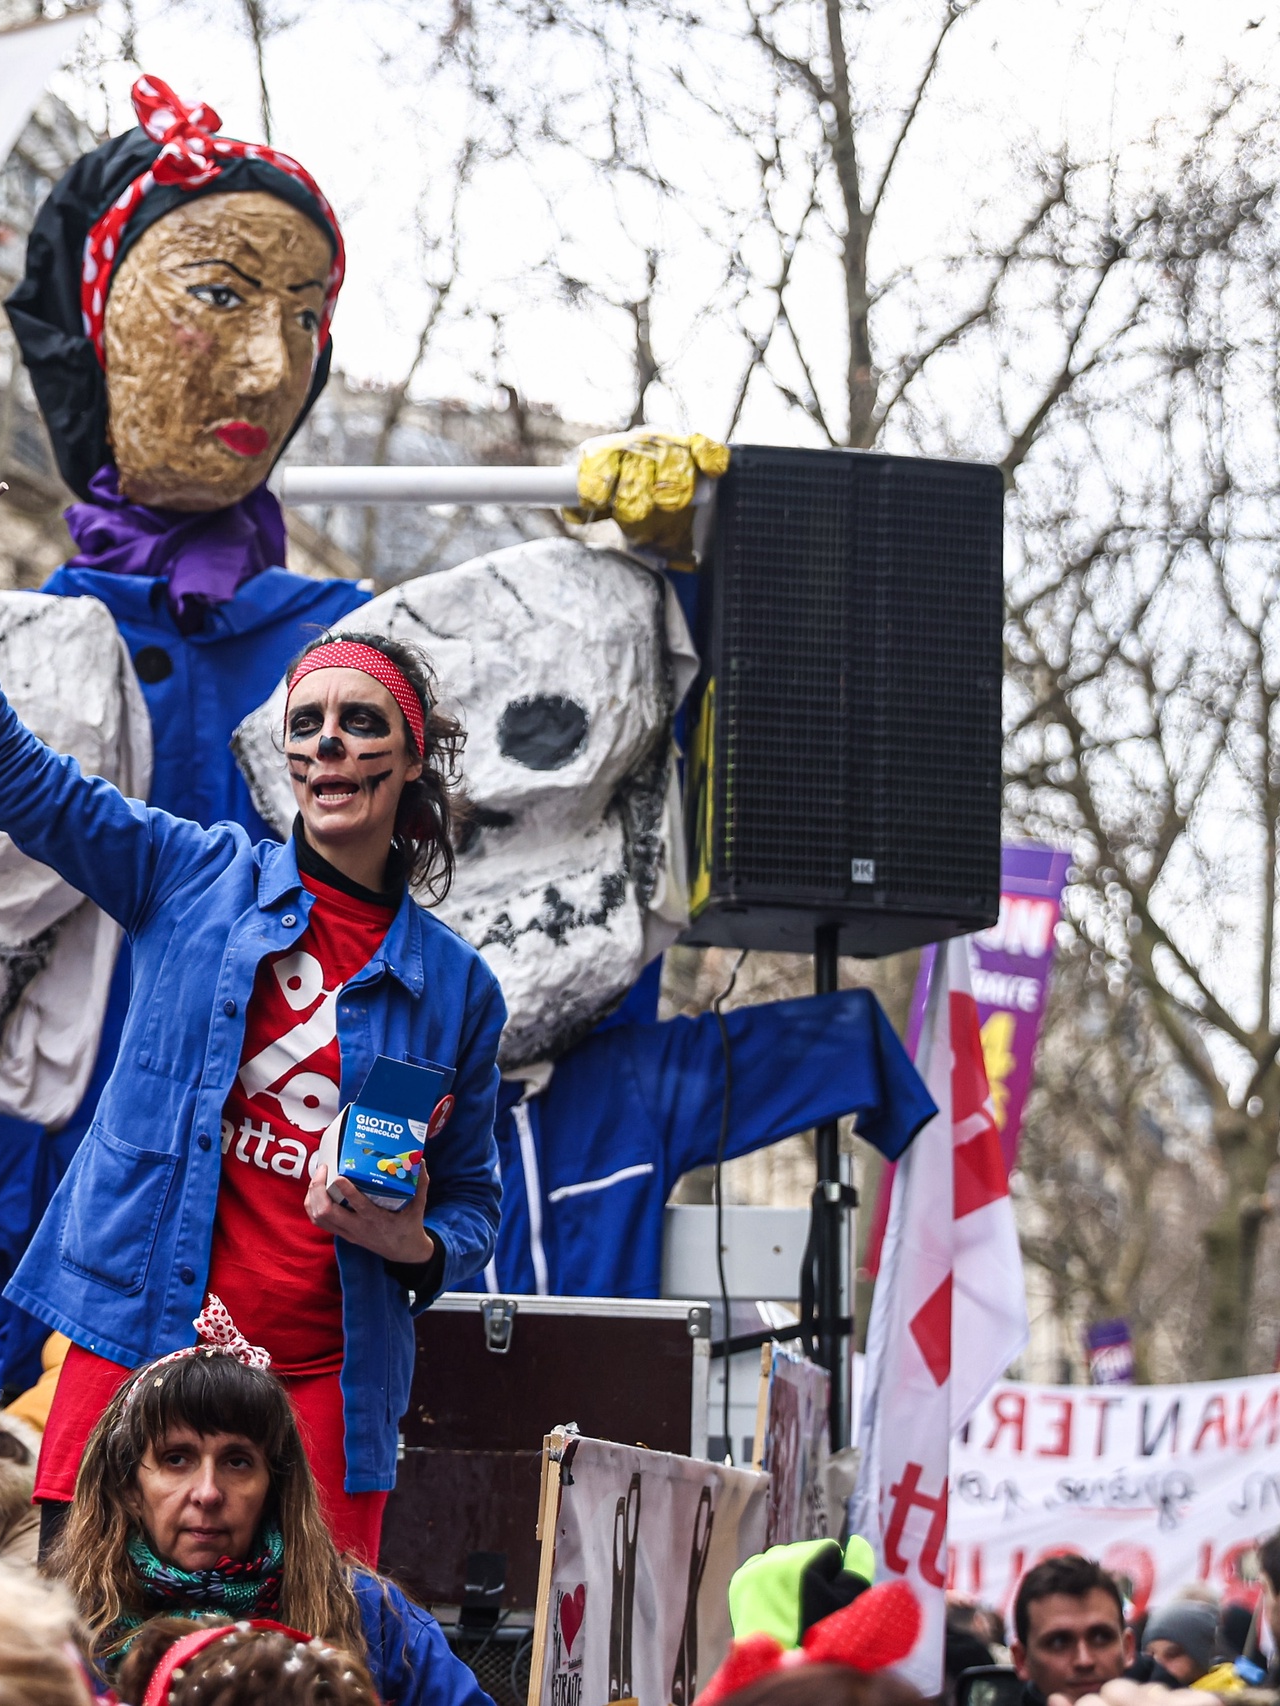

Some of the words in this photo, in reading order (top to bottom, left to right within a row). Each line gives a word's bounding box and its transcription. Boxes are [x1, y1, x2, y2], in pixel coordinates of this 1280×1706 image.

[355, 1113, 404, 1134] GIOTTO
[356, 1123, 400, 1140] ROBERCOLOR
[354, 1131, 366, 1139] 100
